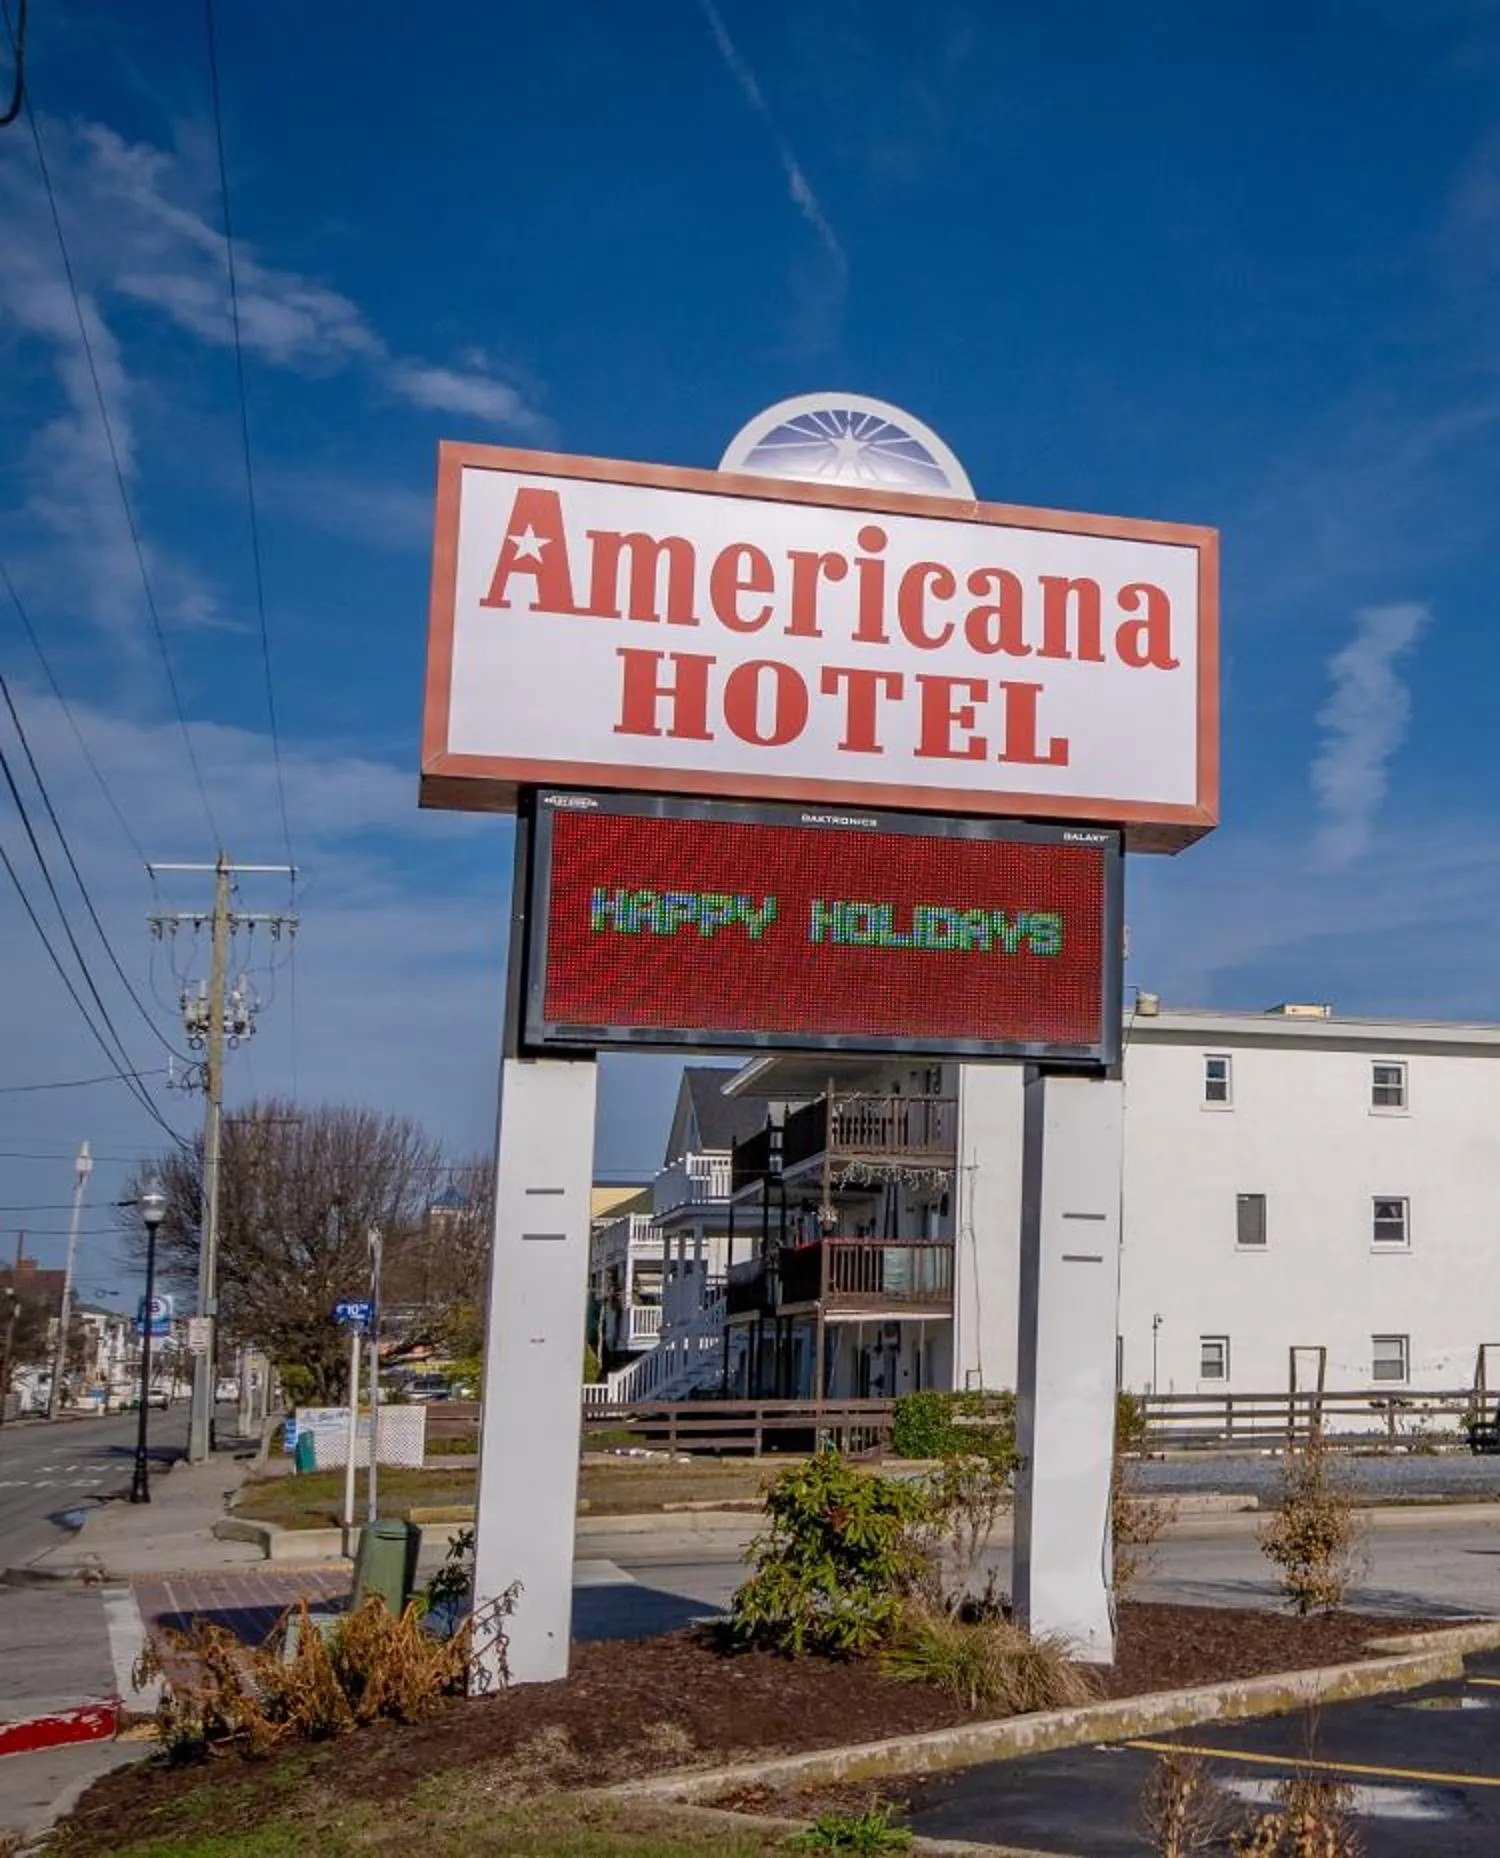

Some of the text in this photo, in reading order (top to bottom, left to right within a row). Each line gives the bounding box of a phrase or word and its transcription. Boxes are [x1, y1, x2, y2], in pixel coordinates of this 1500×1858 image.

[479, 487, 1180, 671] Americana
[613, 647, 1070, 767] HOTEL
[590, 886, 1063, 956] HAPPY HOLIDAYS
